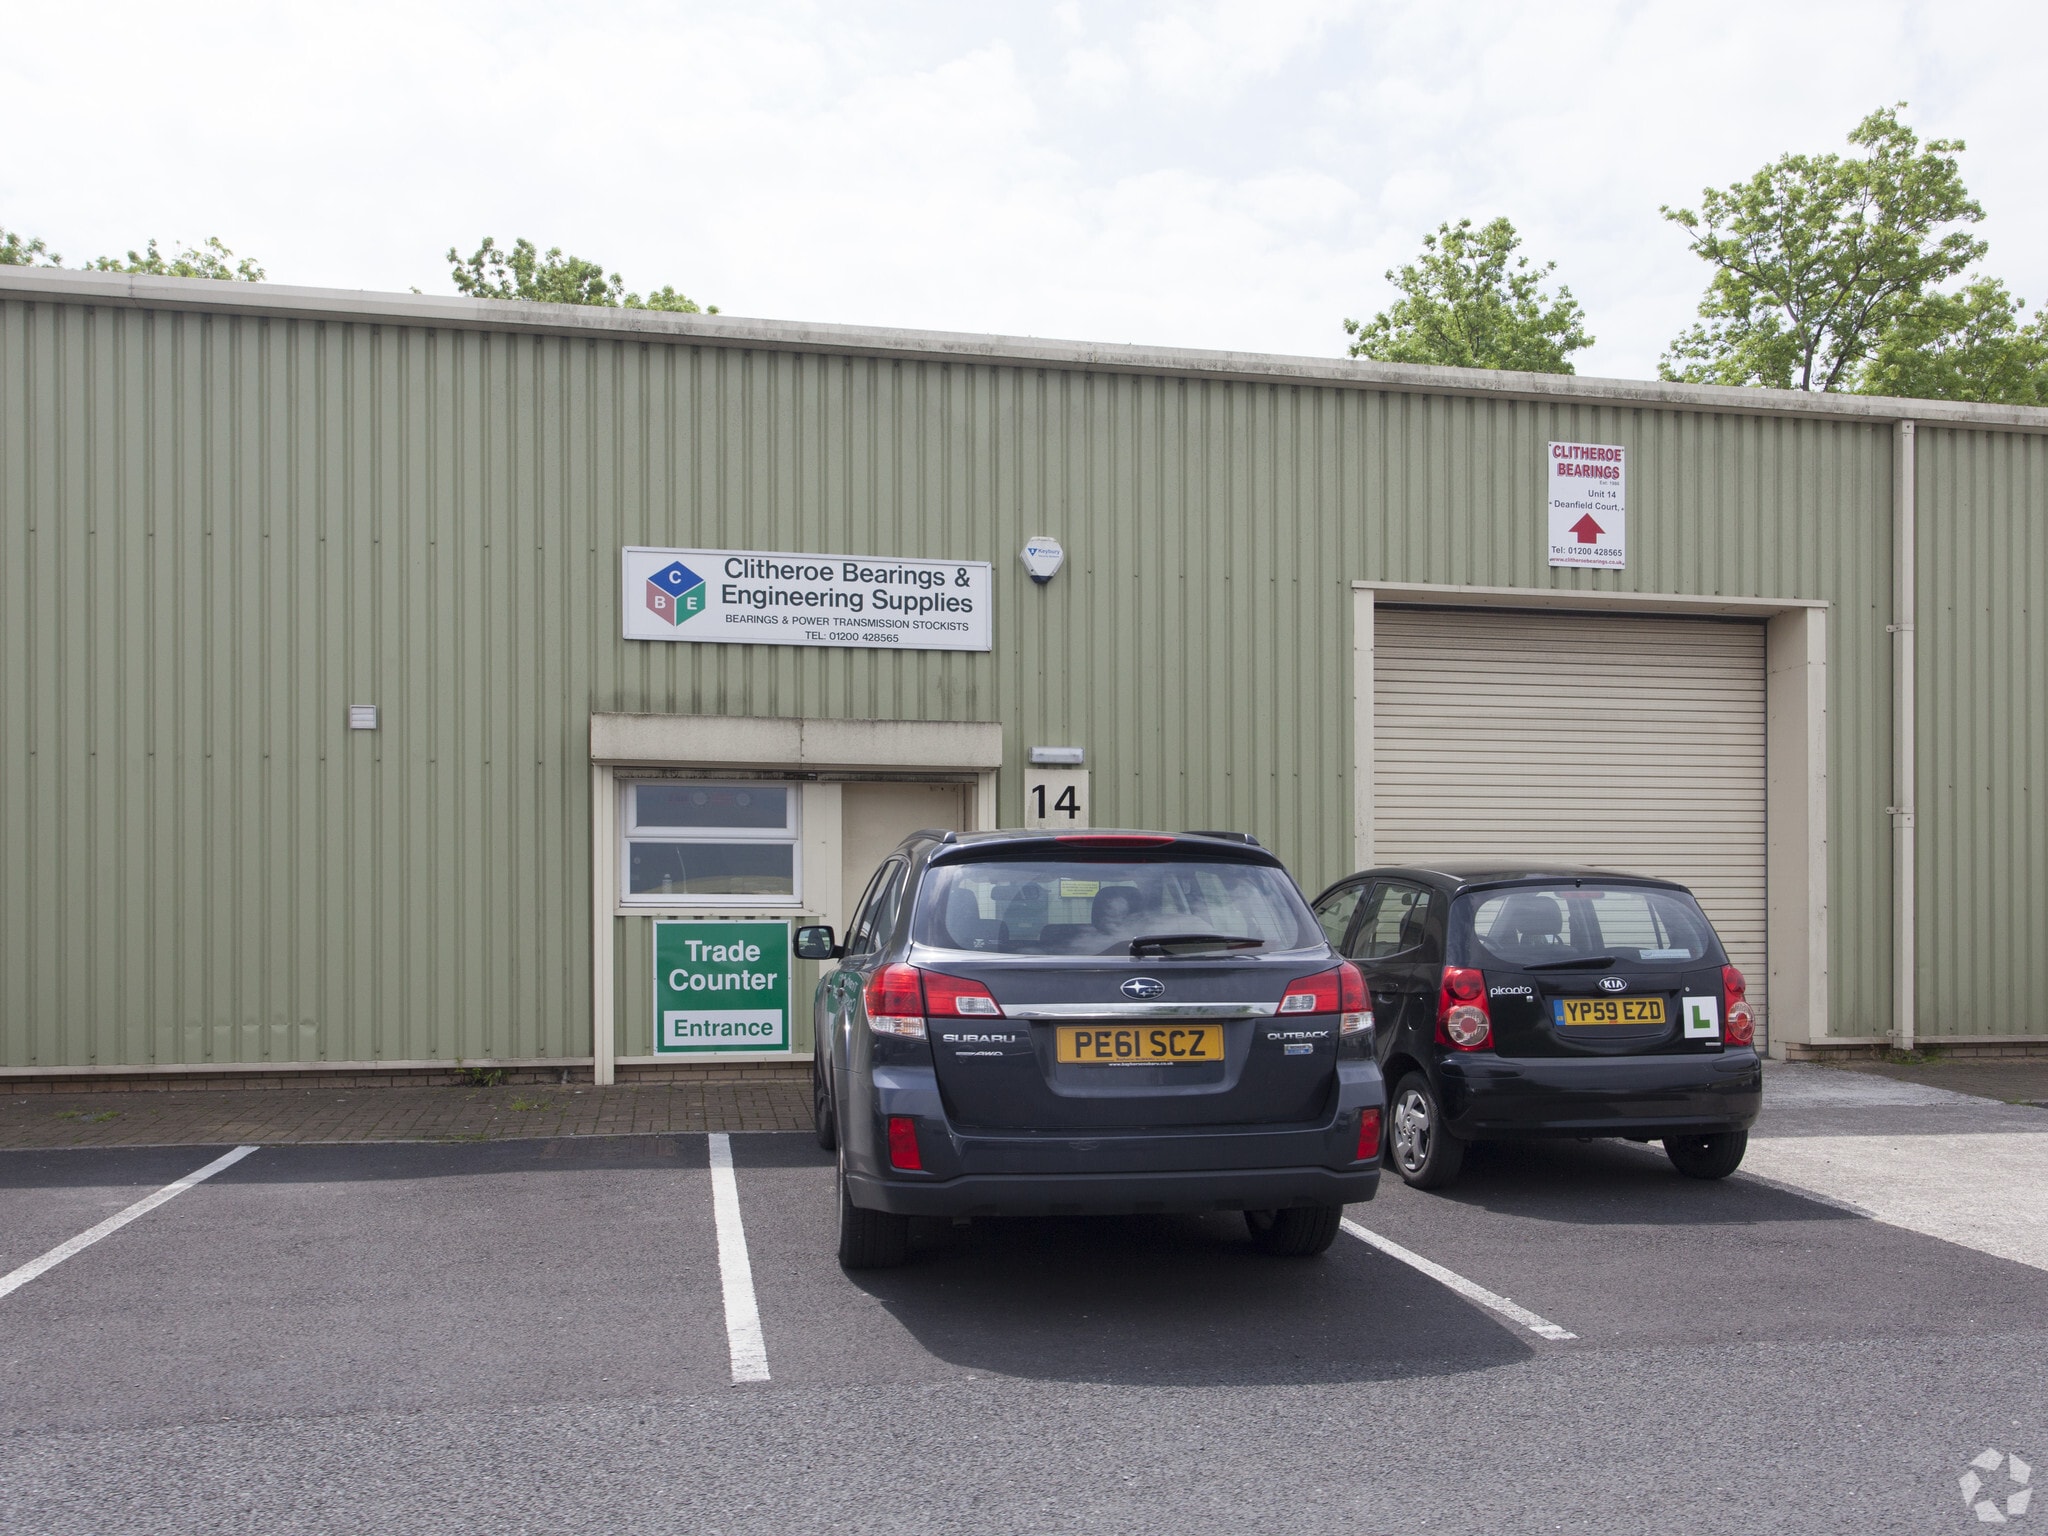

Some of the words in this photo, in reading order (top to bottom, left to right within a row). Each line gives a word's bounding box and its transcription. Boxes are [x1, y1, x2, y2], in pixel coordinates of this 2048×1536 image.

[1552, 445, 1622, 462] CLITHEROE
[1557, 463, 1620, 480] BEARINGS
[1588, 490, 1605, 498] Unit
[1607, 491, 1617, 499] 14
[1554, 500, 1593, 510] Deanfield
[1595, 503, 1620, 512] Court,
[1552, 546, 1566, 554] Tel:
[1568, 547, 1592, 555] 01200
[1594, 548, 1623, 557] 428565
[668, 570, 682, 584] C
[724, 557, 834, 582] Clitheroe
[843, 562, 946, 590] Bearings
[954, 567, 970, 587] &
[654, 595, 666, 609] B
[686, 597, 697, 610] E
[722, 584, 863, 613] Engineering
[872, 588, 973, 616] Supplies
[725, 614, 779, 625] BEARINGS
[781, 616, 789, 625] &
[792, 616, 830, 626] POWER
[833, 617, 910, 629] TRANSMISSION
[912, 620, 969, 632] STOCKISTS
[805, 630, 826, 640] TEL:
[829, 632, 859, 642] 01200
[862, 633, 899, 643] 428565
[1031, 784, 1081, 819] 14
[684, 939, 761, 963] Trade
[668, 969, 778, 992] Counter
[1603, 980, 1624, 989] KIA
[1490, 986, 1532, 998] picanto
[1566, 1002, 1618, 1022] YP59
[1622, 1001, 1662, 1021] EZD
[1692, 1005, 1711, 1029] L
[674, 1018, 774, 1038] Entrance
[1267, 1030, 1329, 1040] OUTBACK
[942, 1034, 1016, 1043] SUBARU
[1075, 1031, 1140, 1058] PE61
[1150, 1030, 1206, 1057] SCZ
